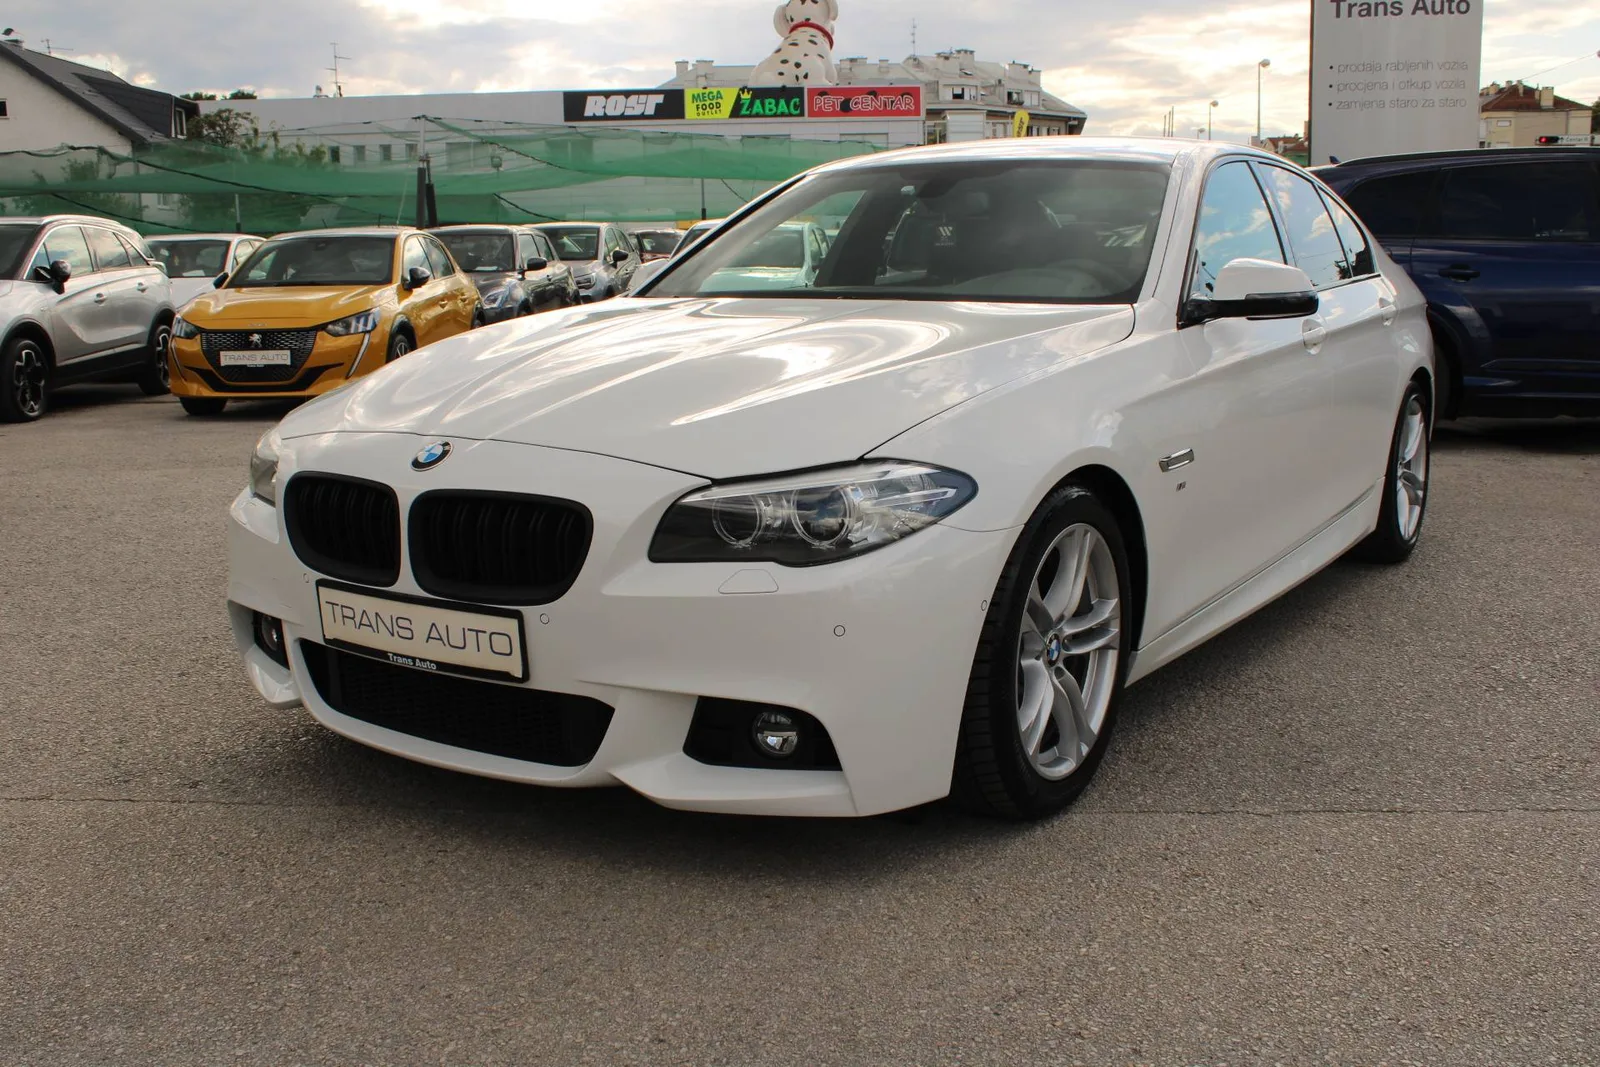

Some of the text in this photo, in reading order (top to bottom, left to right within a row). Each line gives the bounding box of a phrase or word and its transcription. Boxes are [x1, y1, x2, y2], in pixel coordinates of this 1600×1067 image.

[1329, 0, 1471, 18] Trans Auto
[1337, 60, 1469, 74] prodaja rabljenih vozila
[1337, 80, 1389, 94] procjena
[1398, 78, 1431, 92] otkup
[1434, 78, 1466, 90] vozila
[691, 90, 723, 103] MEGA
[814, 94, 915, 111] PET CENTAR
[1336, 97, 1467, 111] zamjena staro za staro
[584, 94, 665, 117] ROST
[696, 101, 721, 111] FOOD
[696, 109, 722, 117] OUTLET
[223, 352, 289, 362] TRANS AUTO
[325, 600, 513, 657] TRANS AUTO
[387, 652, 437, 670] Trans Auto
